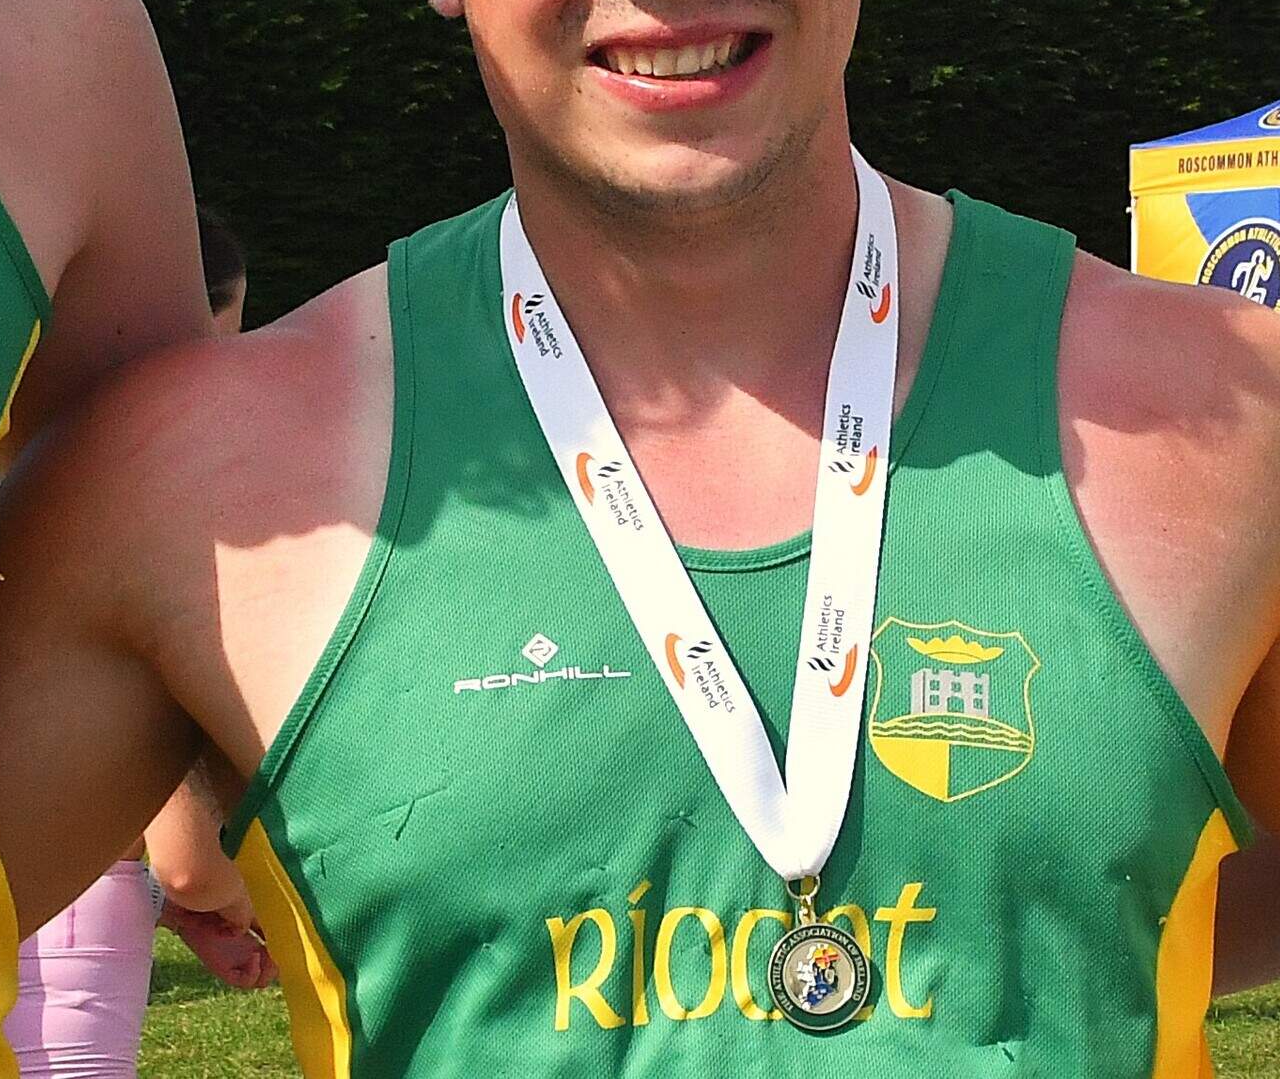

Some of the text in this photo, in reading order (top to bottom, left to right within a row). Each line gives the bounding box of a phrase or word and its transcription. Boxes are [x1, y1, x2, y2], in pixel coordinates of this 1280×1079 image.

[1178, 152, 1253, 174] ROSCOMMON
[528, 317, 550, 357] Ireland
[534, 311, 563, 359] Athletics
[836, 404, 851, 454] Athletics
[850, 416, 863, 456] Ireland
[601, 484, 629, 526] Ireland
[614, 480, 644, 531] Athletics
[816, 594, 832, 652] Athletics
[829, 608, 845, 654] Ireland
[453, 664, 632, 695] RONHILL
[691, 665, 721, 709] Ireland
[703, 661, 736, 713] Athletics
